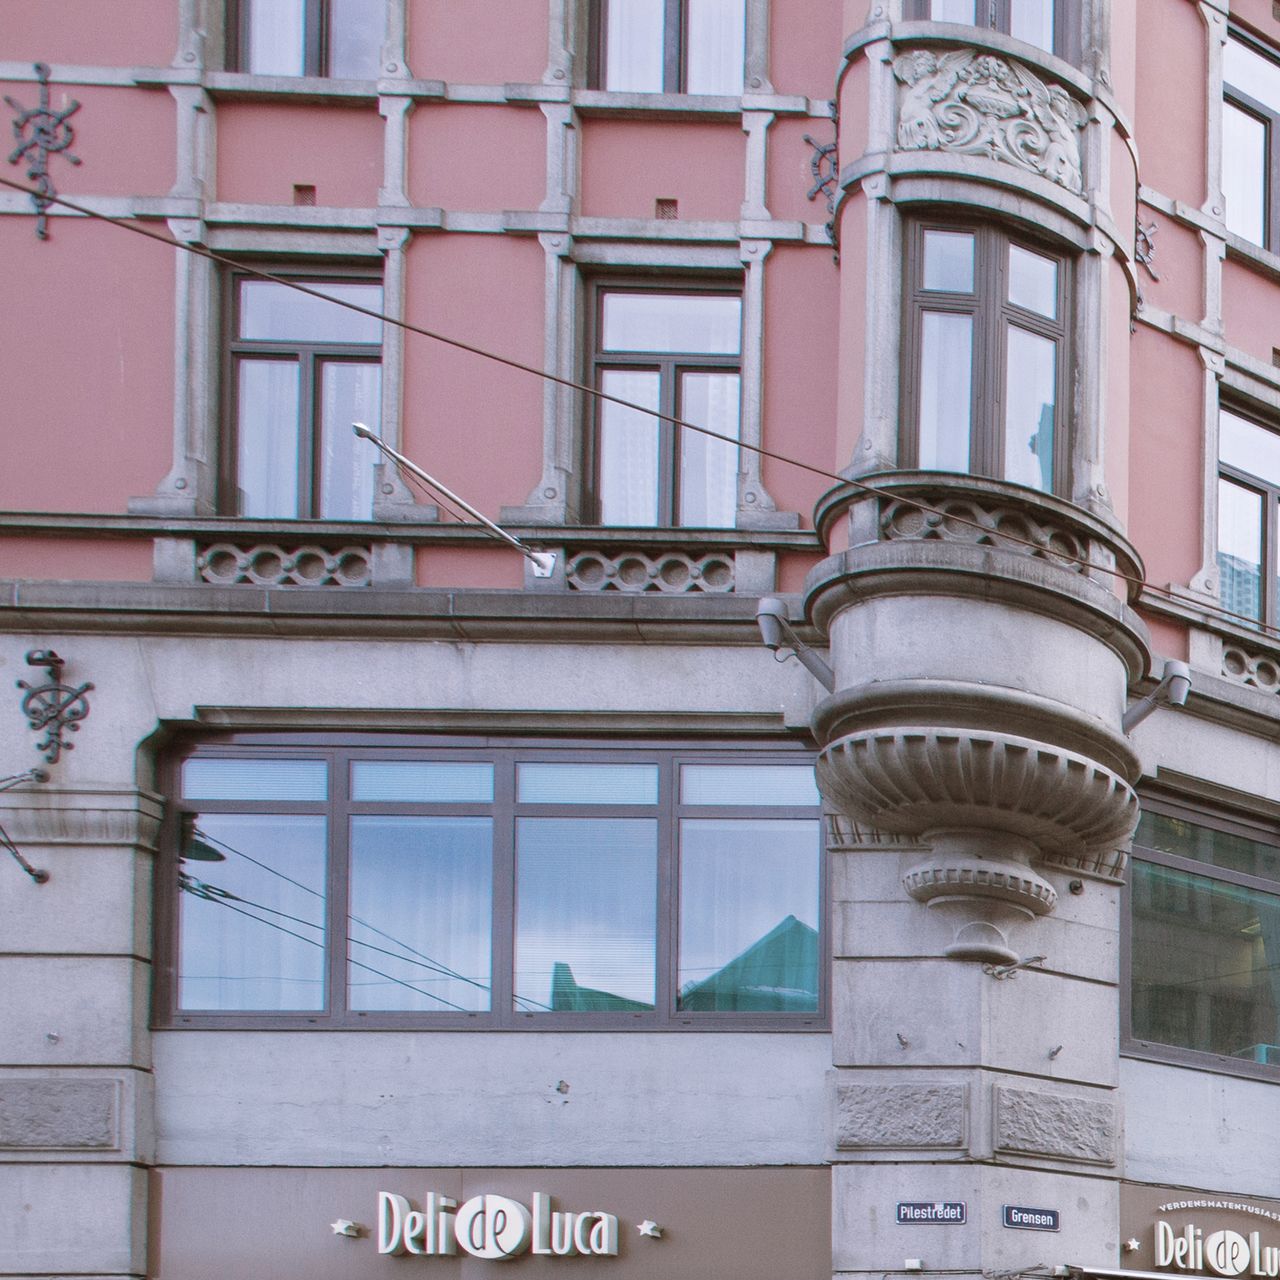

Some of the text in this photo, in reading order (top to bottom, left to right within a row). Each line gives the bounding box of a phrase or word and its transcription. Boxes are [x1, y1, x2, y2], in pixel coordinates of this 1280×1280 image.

[378, 1191, 457, 1254] Deli
[532, 1191, 618, 1255] Luca
[900, 1206, 962, 1219] Pilestredet
[1011, 1209, 1054, 1226] Grensen
[1154, 1220, 1203, 1270] Deli
